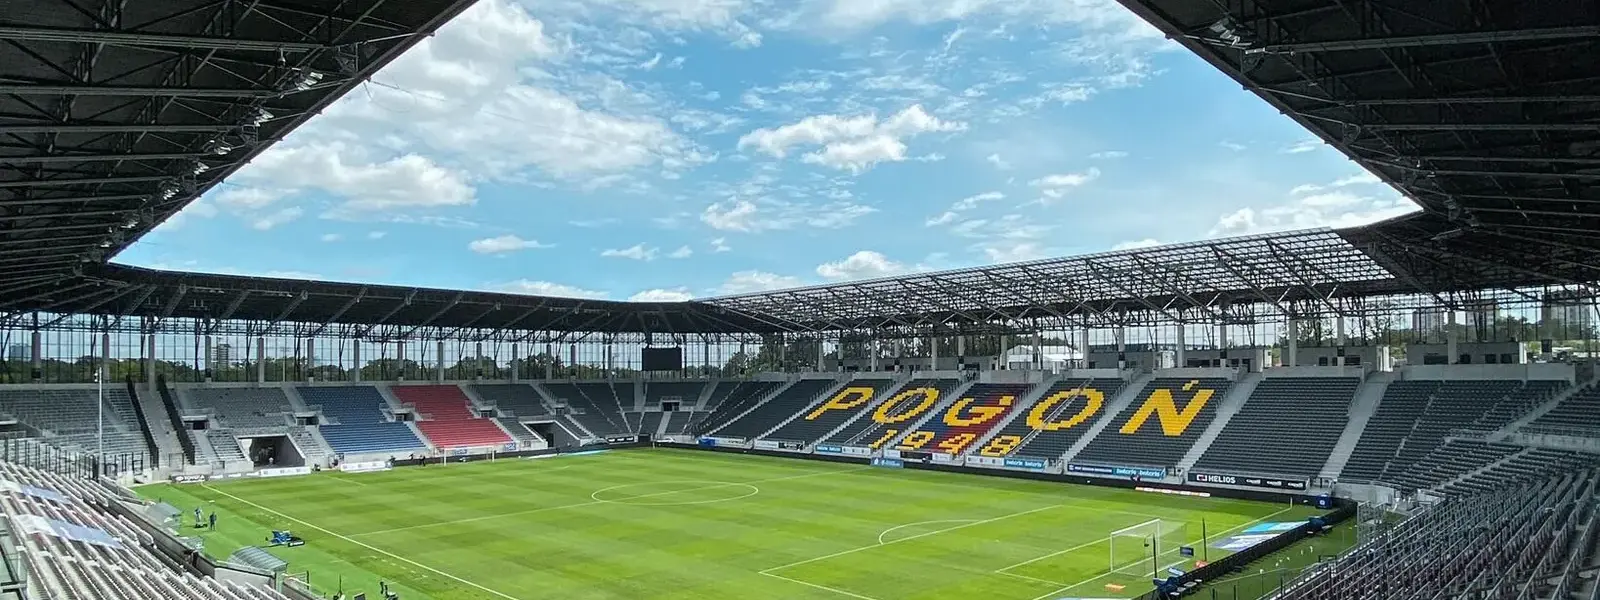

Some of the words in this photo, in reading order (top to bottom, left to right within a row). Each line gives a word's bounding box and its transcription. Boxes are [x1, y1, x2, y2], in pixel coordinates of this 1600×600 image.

[806, 380, 1215, 437] POGOŃ
[868, 429, 1022, 457] 1948
[1208, 474, 1236, 484] HELIOS
